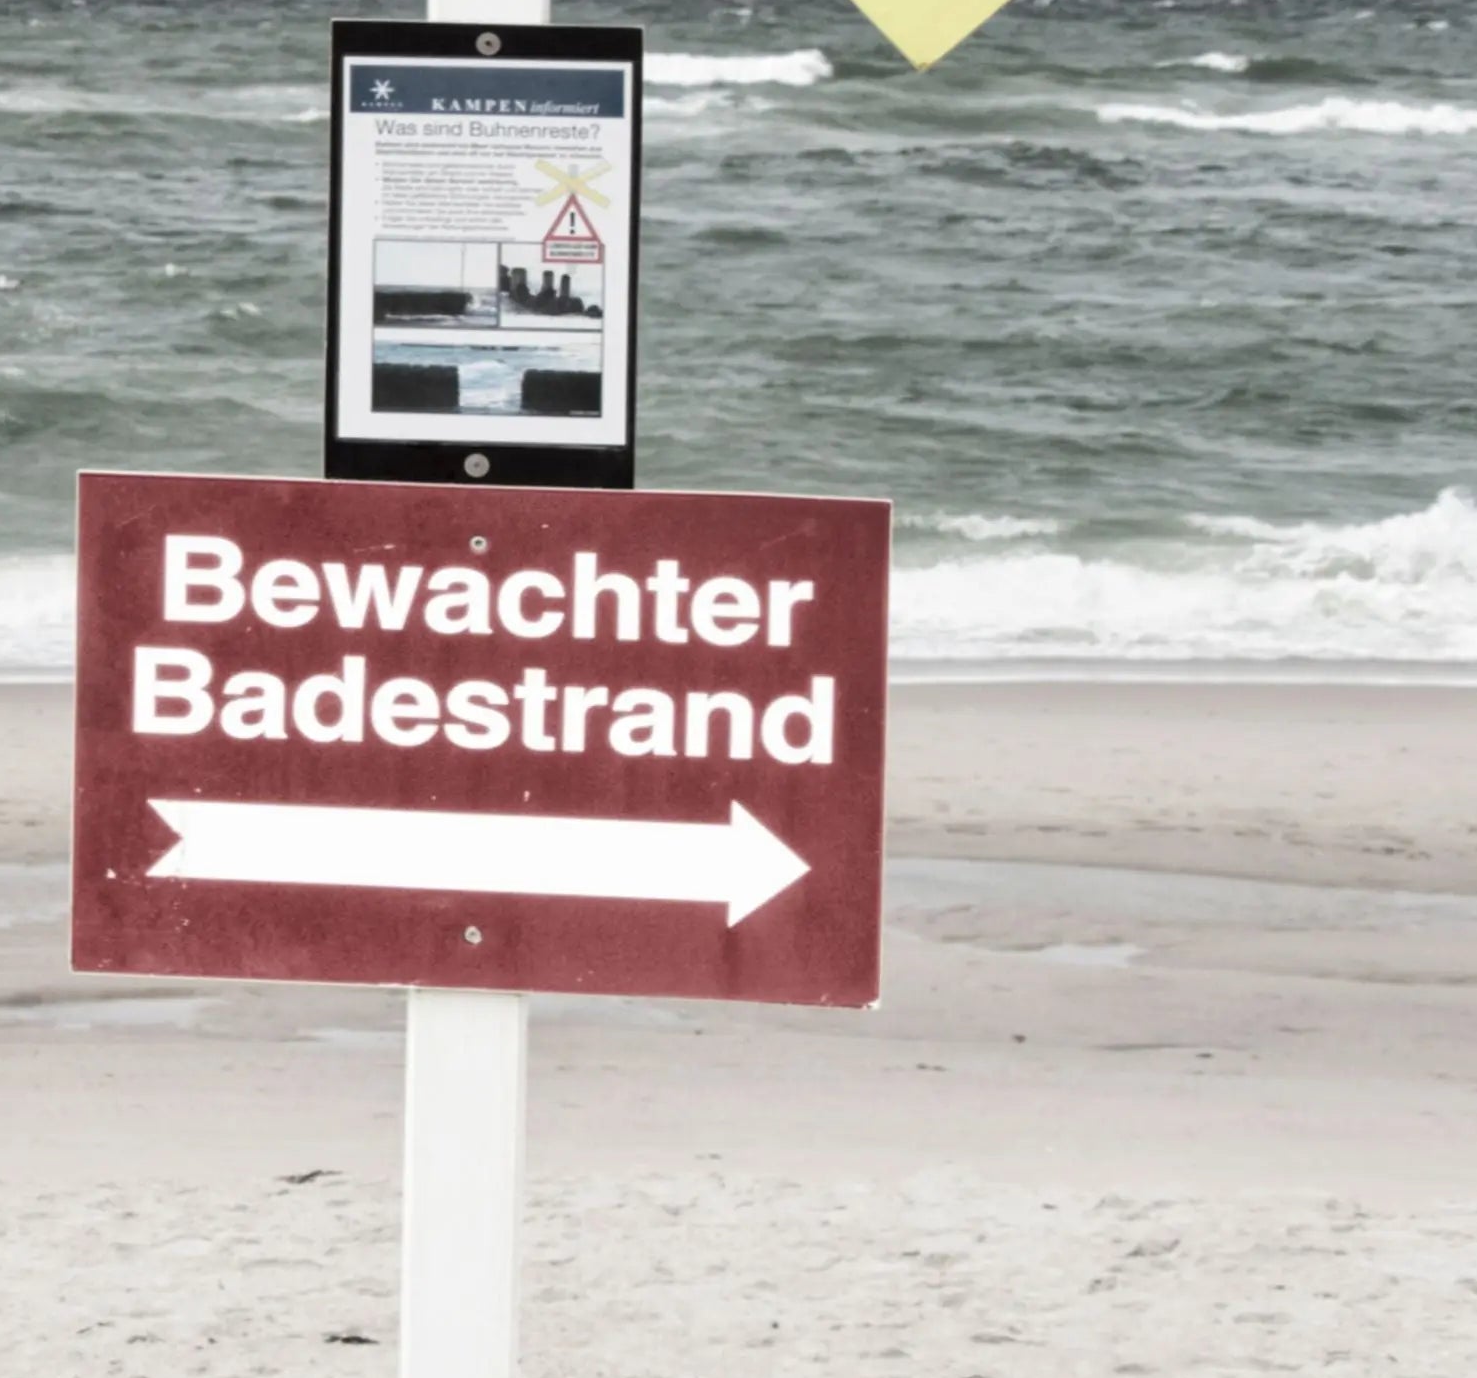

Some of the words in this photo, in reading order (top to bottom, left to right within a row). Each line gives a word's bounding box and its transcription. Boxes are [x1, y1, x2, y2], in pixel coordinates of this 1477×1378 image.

[374, 119, 417, 136] Was
[423, 120, 463, 137] sind
[469, 121, 601, 139] Buhnenreste?
[162, 533, 815, 648] Bewachter
[131, 645, 836, 766] Badestrand
